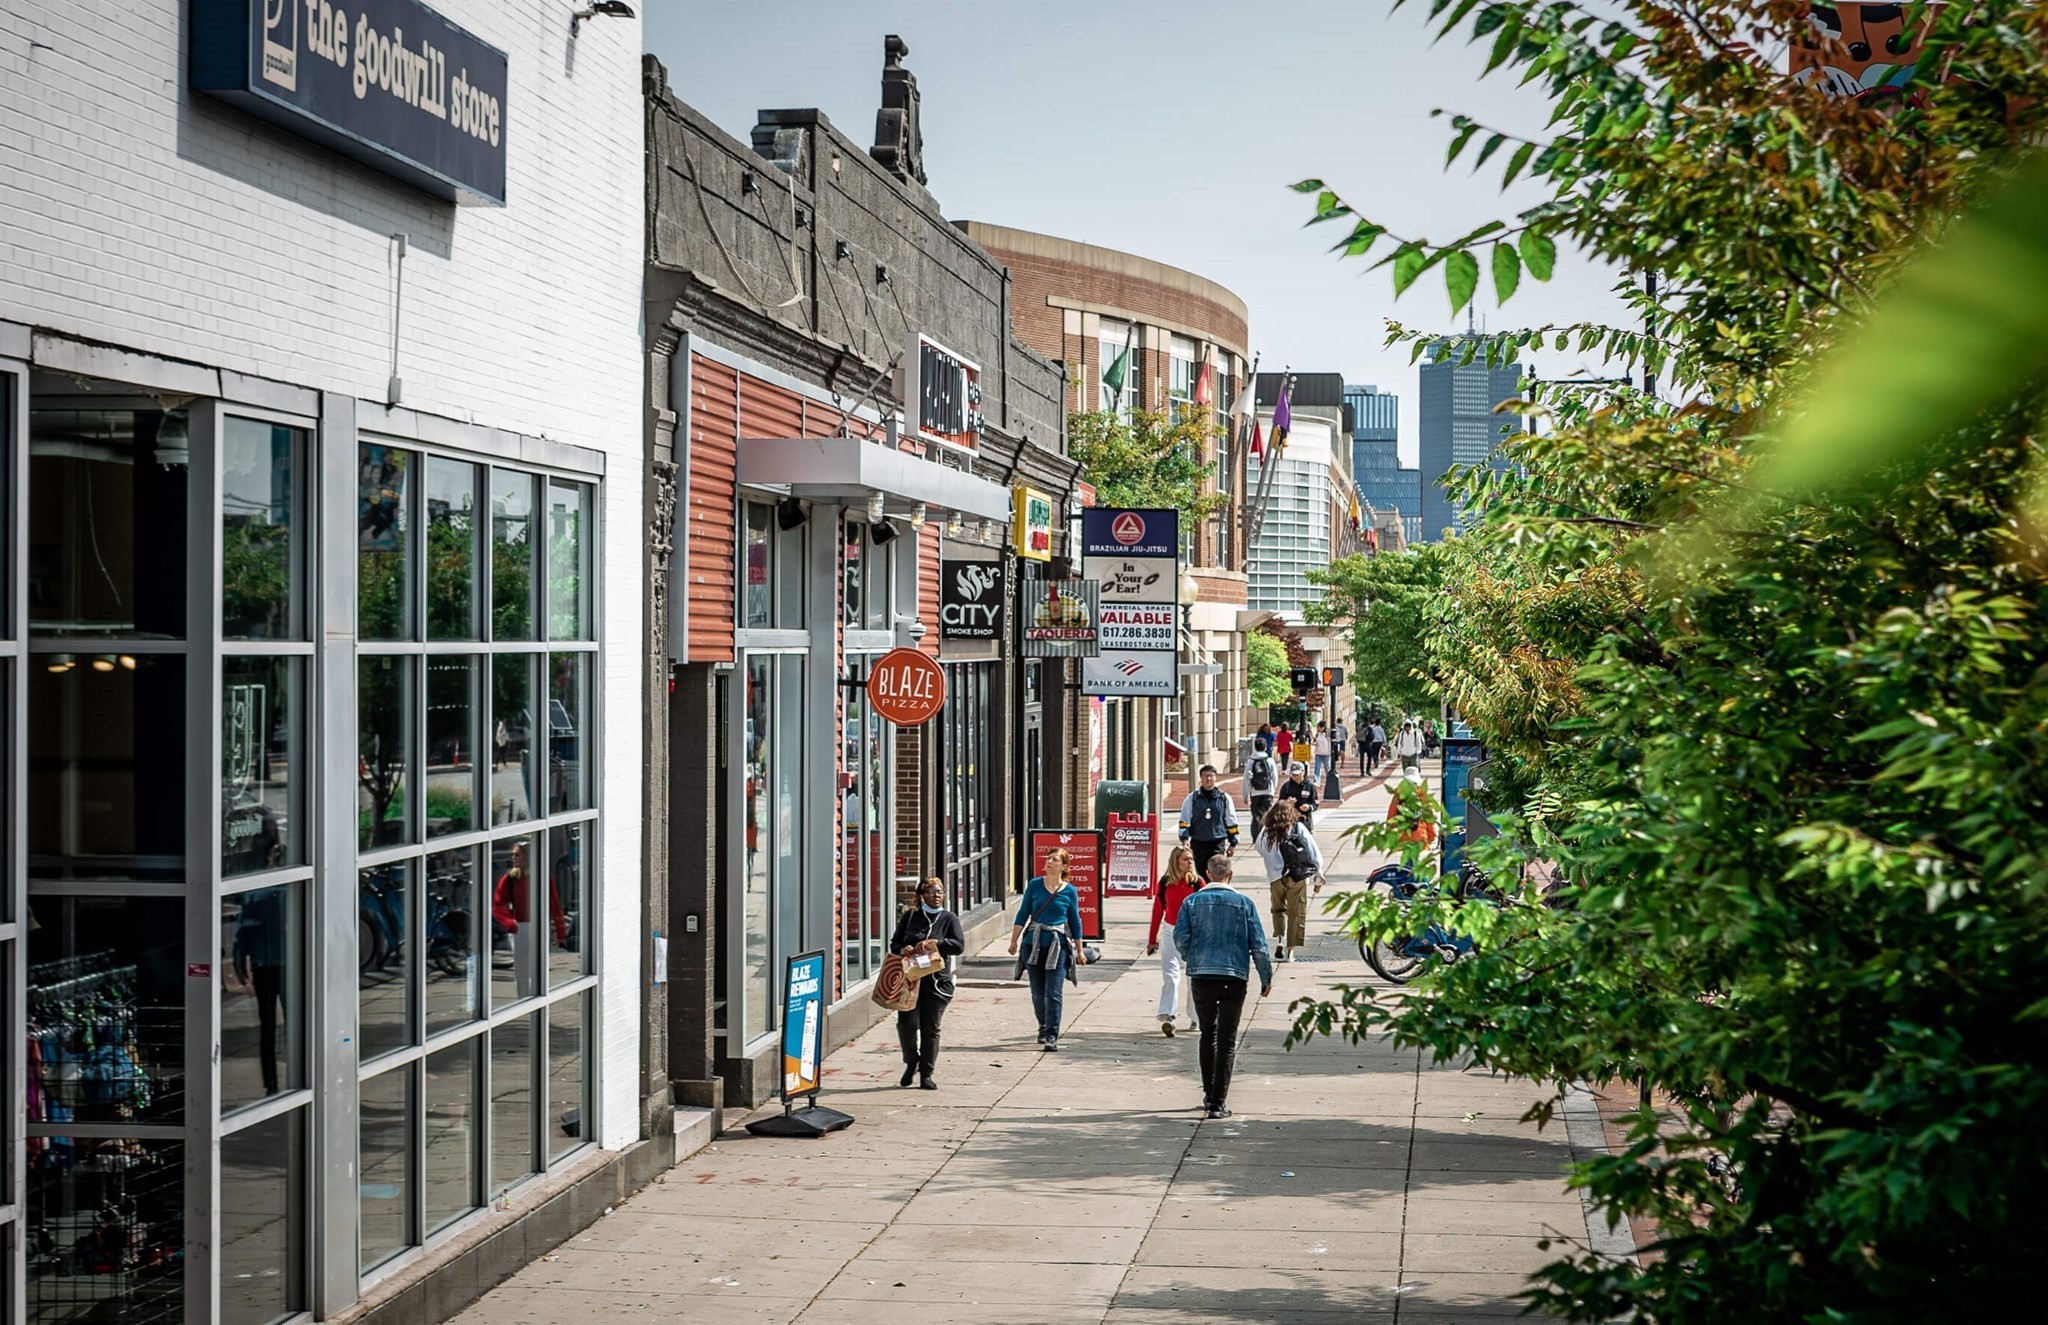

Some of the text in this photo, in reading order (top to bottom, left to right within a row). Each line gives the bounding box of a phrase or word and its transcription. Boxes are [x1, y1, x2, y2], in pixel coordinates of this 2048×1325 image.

[306, 0, 500, 148] the goodwill store
[1089, 544, 1129, 552] BRAZILIAN
[1122, 562, 1135, 572] In
[1114, 572, 1143, 583] Your
[1116, 584, 1140, 594] Ear!
[942, 603, 1000, 626] CITY
[1100, 612, 1172, 624] VAILABLE
[1028, 629, 1095, 639] TAQUERIA
[1102, 626, 1171, 639] 617.286.3830
[879, 666, 934, 699] BLAZE
[882, 698, 930, 709] PIZZA
[792, 964, 812, 982] BLAZE
